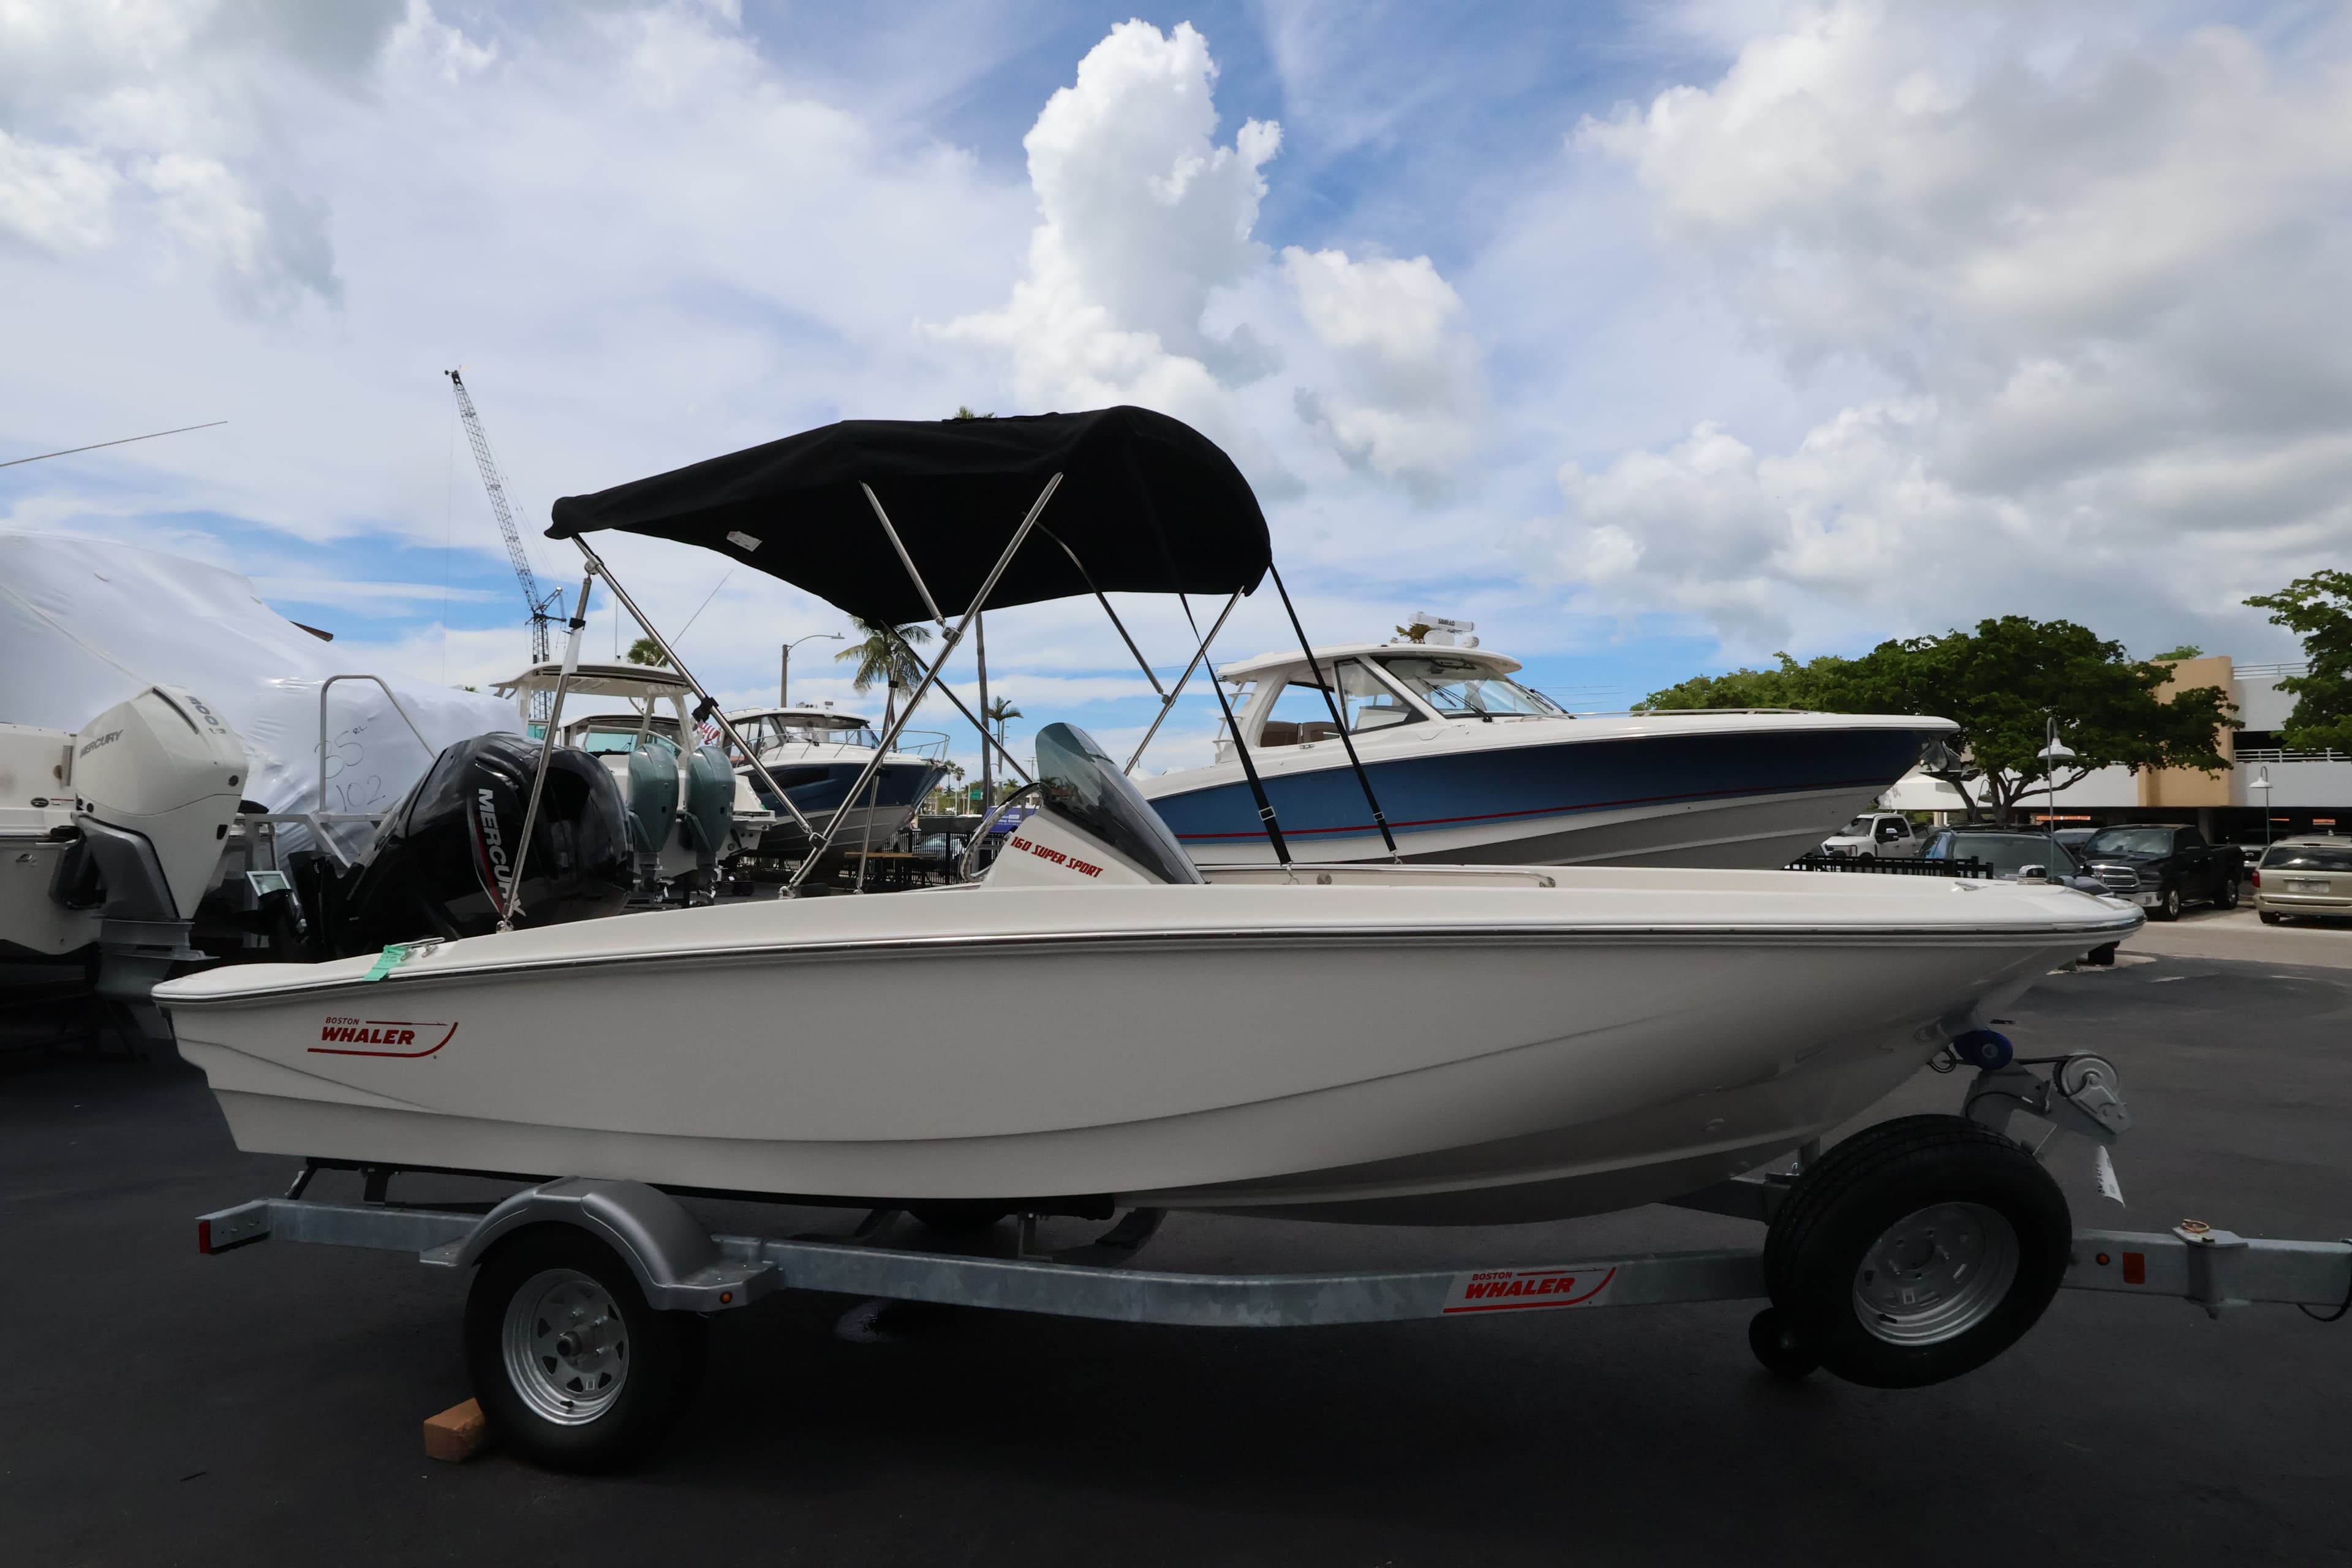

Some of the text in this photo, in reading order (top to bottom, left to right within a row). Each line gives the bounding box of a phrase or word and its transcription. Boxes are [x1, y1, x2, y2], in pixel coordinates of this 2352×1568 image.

[186, 696, 219, 725] 300
[80, 730, 123, 758] MERCURY
[336, 775, 385, 812] 102
[1011, 837, 1103, 878] 160 SUPER SPORT
[325, 1017, 360, 1025] BOSTON
[322, 1027, 415, 1045] WHALER
[1465, 1278, 1575, 1299] WHALER
[1472, 1272, 1512, 1281] BOSTON
